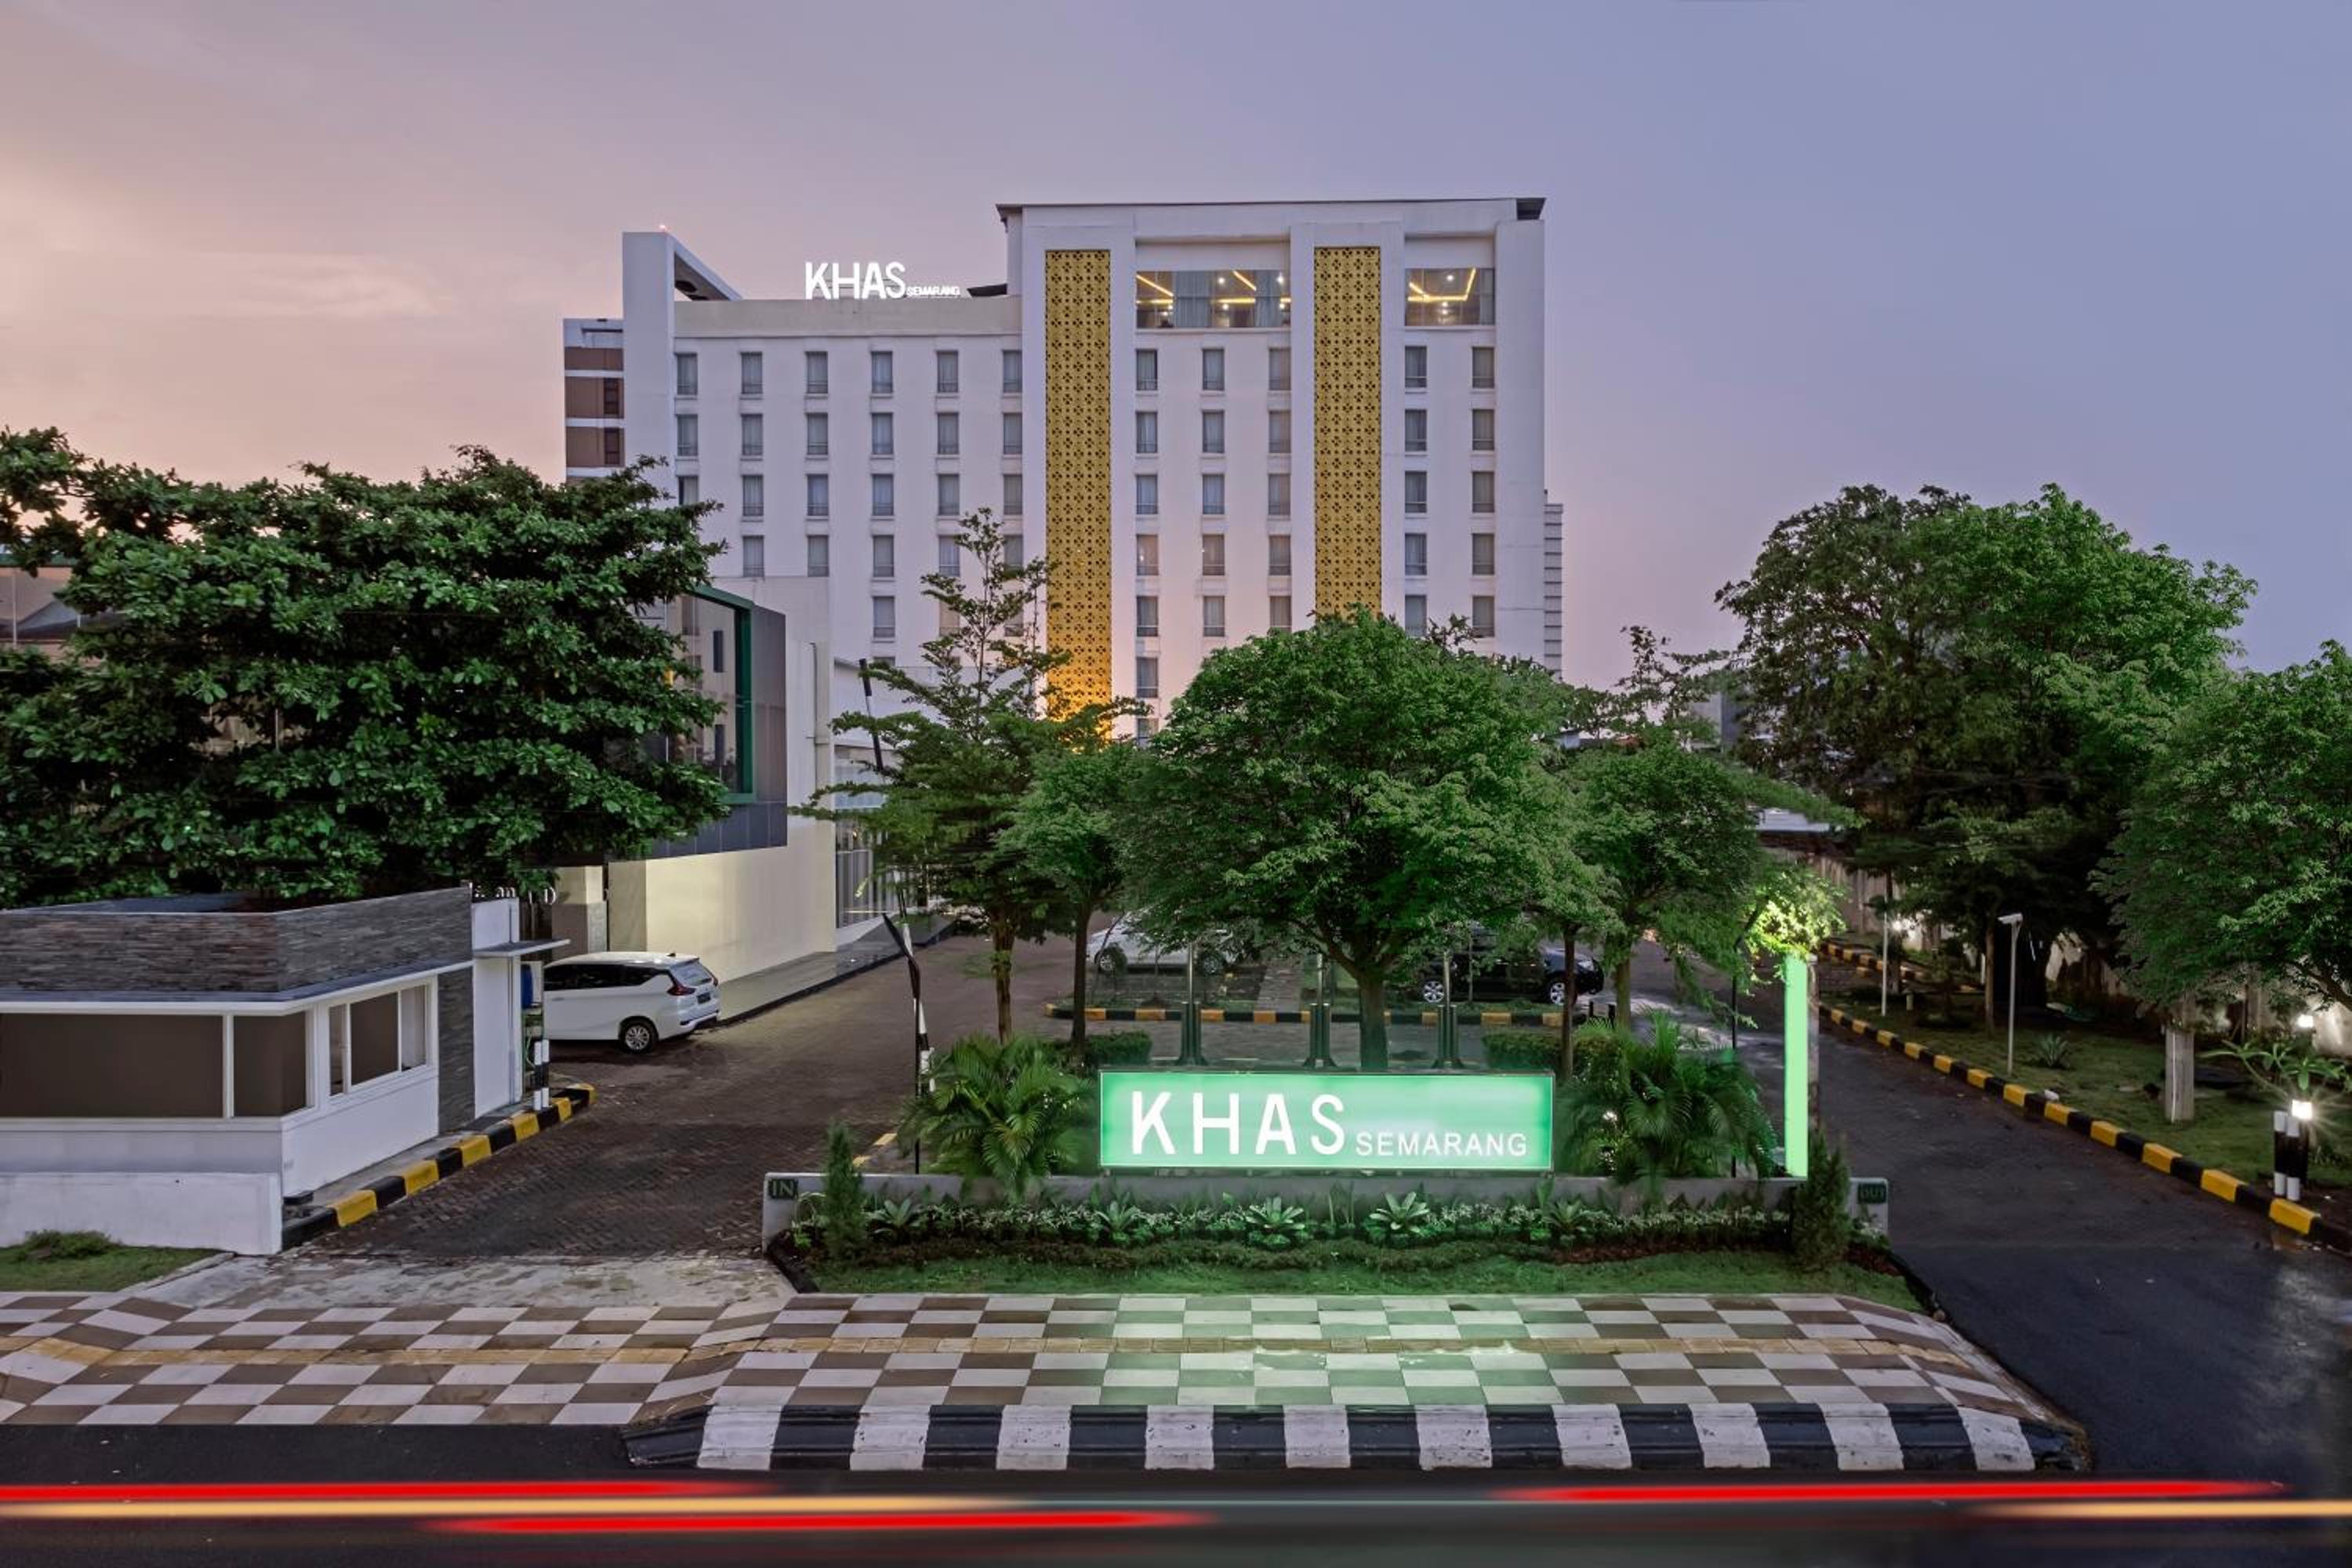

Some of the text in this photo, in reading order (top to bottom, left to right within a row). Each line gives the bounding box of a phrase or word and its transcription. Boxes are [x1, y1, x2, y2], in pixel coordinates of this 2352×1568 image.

[804, 262, 960, 299] KHAS SEMARANG
[1131, 1091, 1528, 1157] KHAS SEMARANG
[772, 1180, 794, 1196] IN
